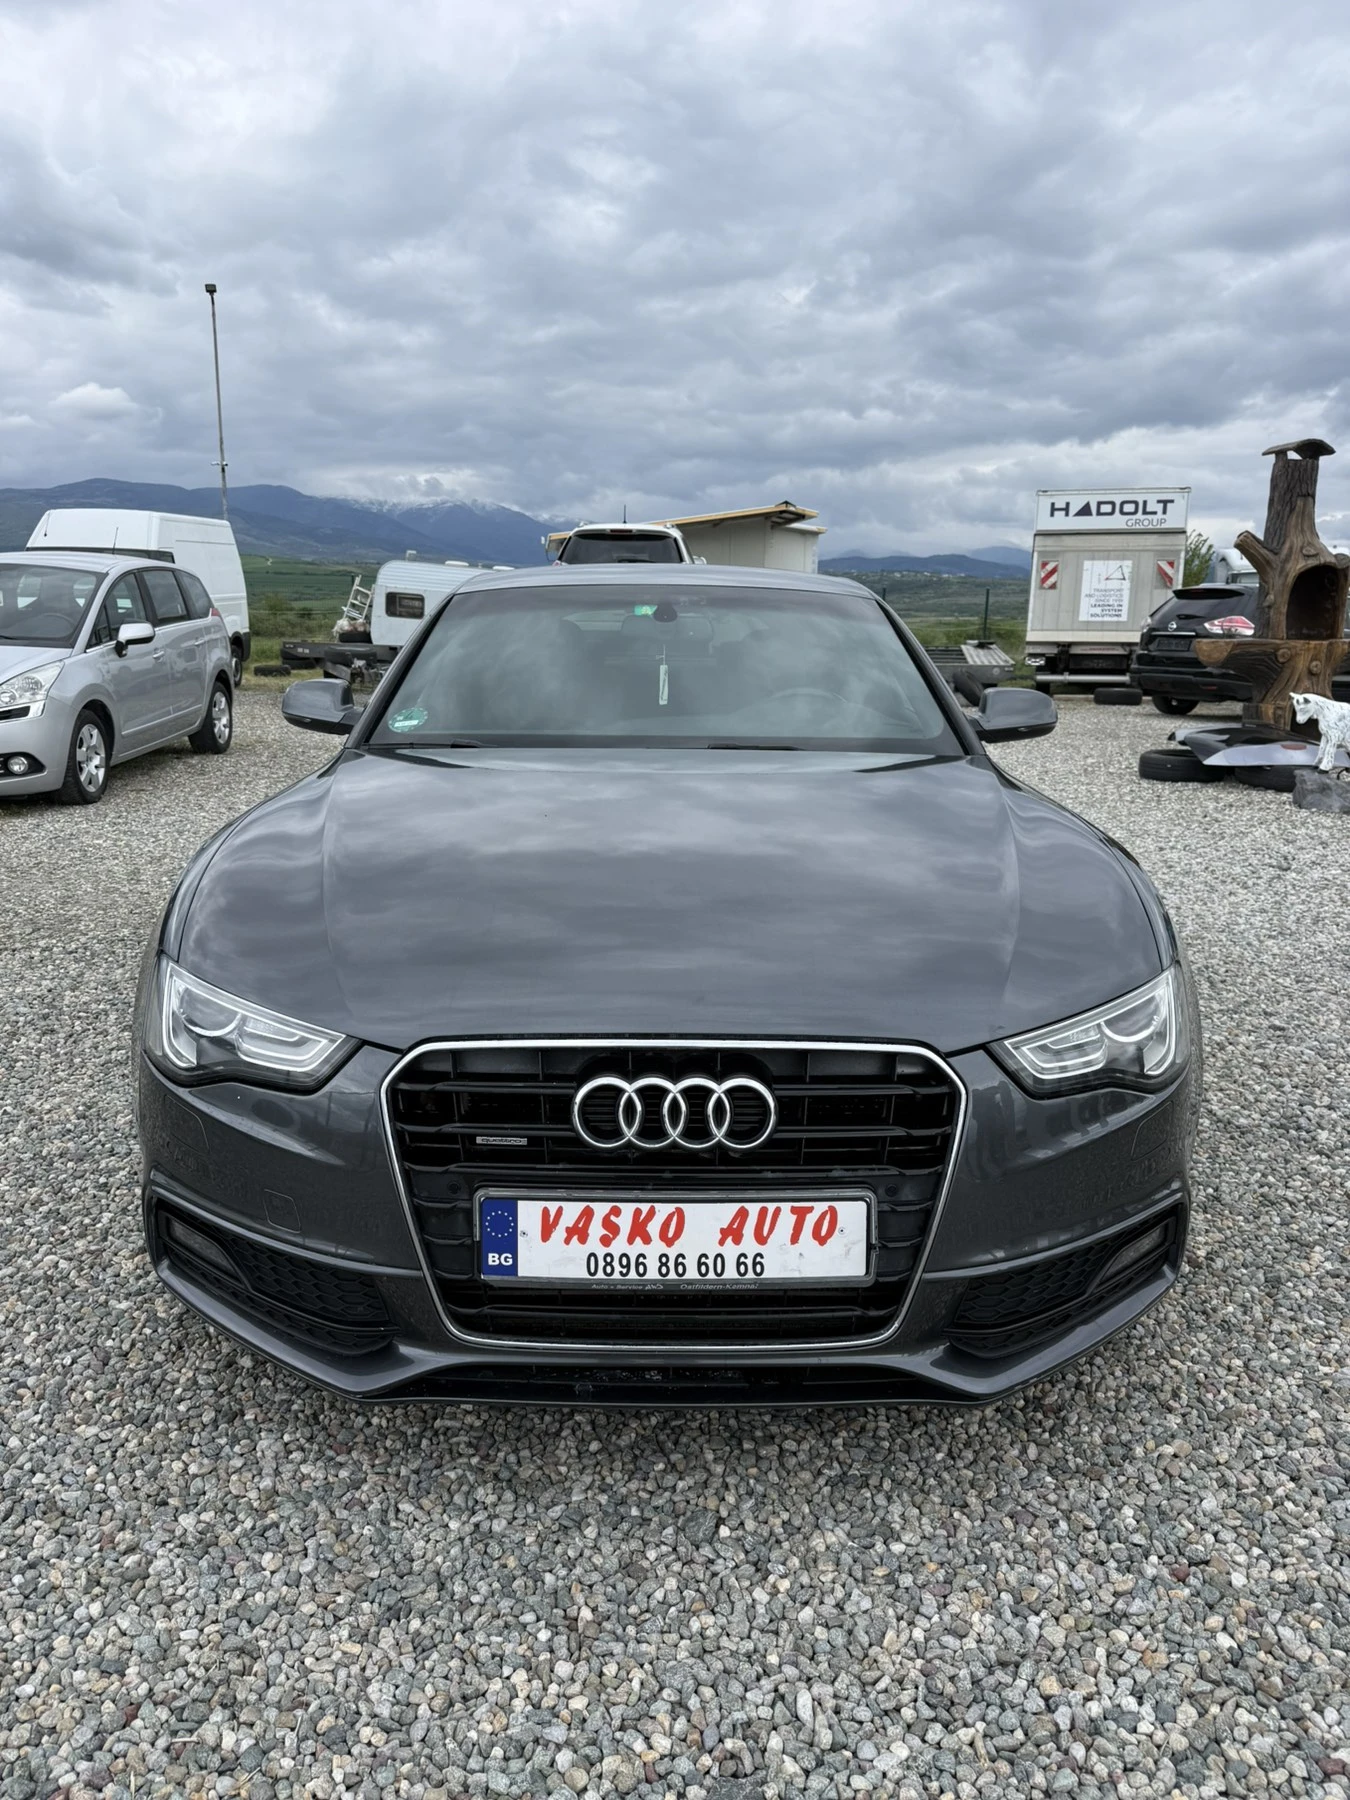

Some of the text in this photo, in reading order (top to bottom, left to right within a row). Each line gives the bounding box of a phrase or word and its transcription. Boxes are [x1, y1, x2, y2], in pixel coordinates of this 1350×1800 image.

[1050, 499, 1175, 518] HADOLT
[1125, 518, 1167, 528] GROUP
[540, 1205, 838, 1248] VASKO AUTO
[487, 1253, 513, 1266] BG
[586, 1252, 765, 1278] 0896 86 60 66
